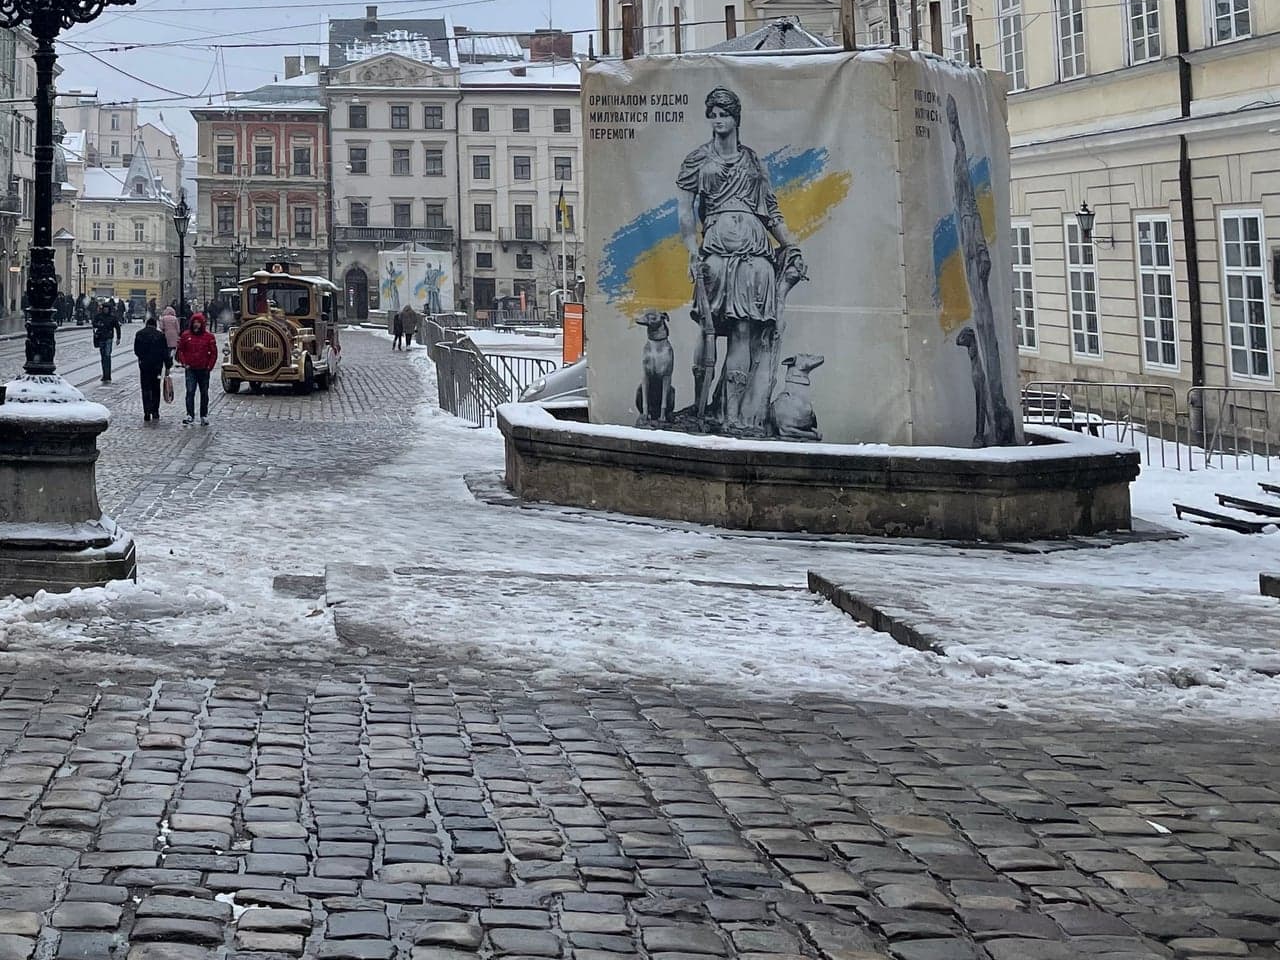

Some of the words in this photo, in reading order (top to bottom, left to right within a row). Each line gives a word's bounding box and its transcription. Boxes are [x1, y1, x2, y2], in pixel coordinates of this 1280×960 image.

[589, 95, 647, 106] ОРИГІНАЛОМ
[650, 94, 689, 106] БУДЕМО
[589, 111, 648, 123] МИЛУВАТИСЯ
[655, 111, 684, 123] ПІСЛЯ
[589, 128, 635, 140] ПЕРЕМОГИ
